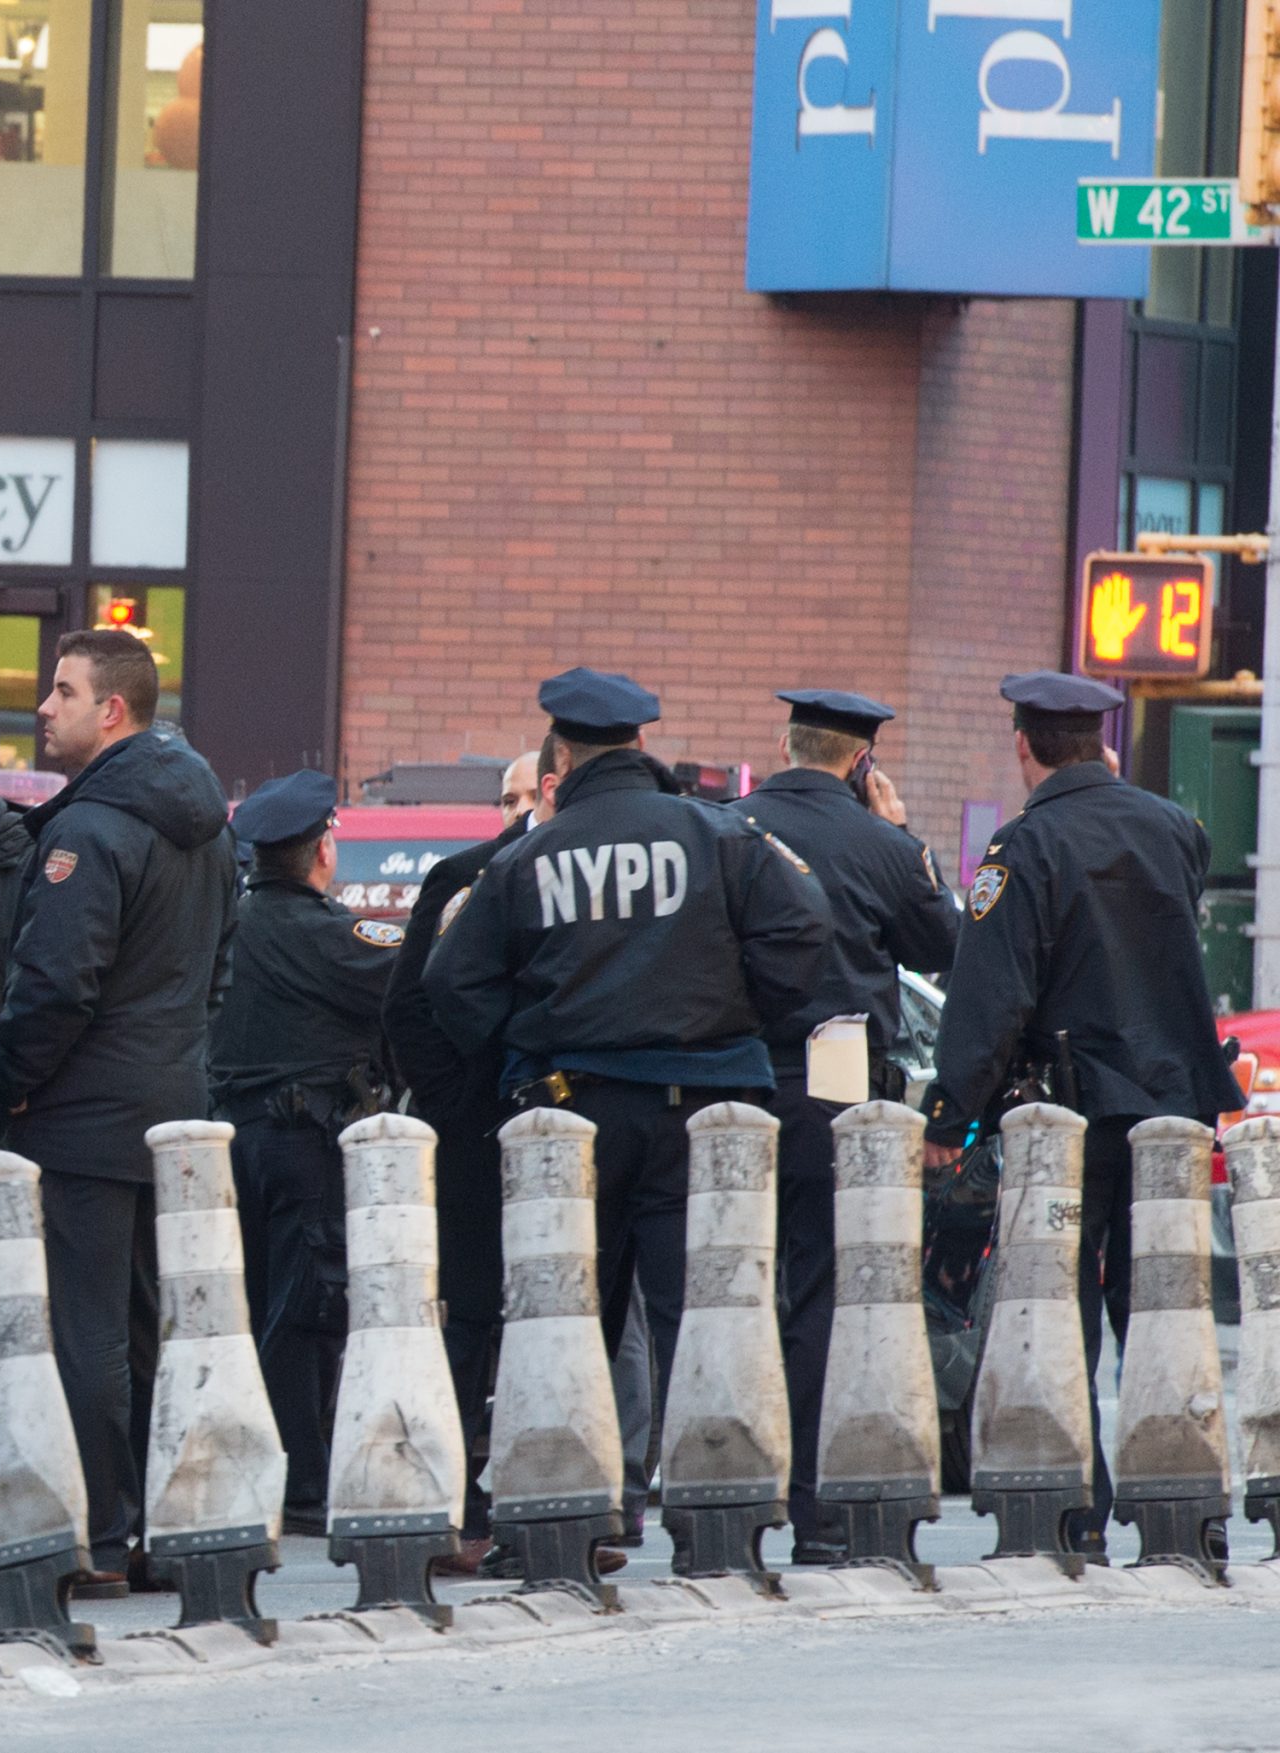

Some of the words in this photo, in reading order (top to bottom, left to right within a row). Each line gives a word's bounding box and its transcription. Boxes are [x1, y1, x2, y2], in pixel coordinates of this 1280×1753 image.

[1087, 187, 1119, 236] W
[1137, 187, 1191, 236] 42
[1201, 187, 1231, 213] ST
[1158, 579, 1201, 658] 12
[534, 840, 688, 928] NYPD
